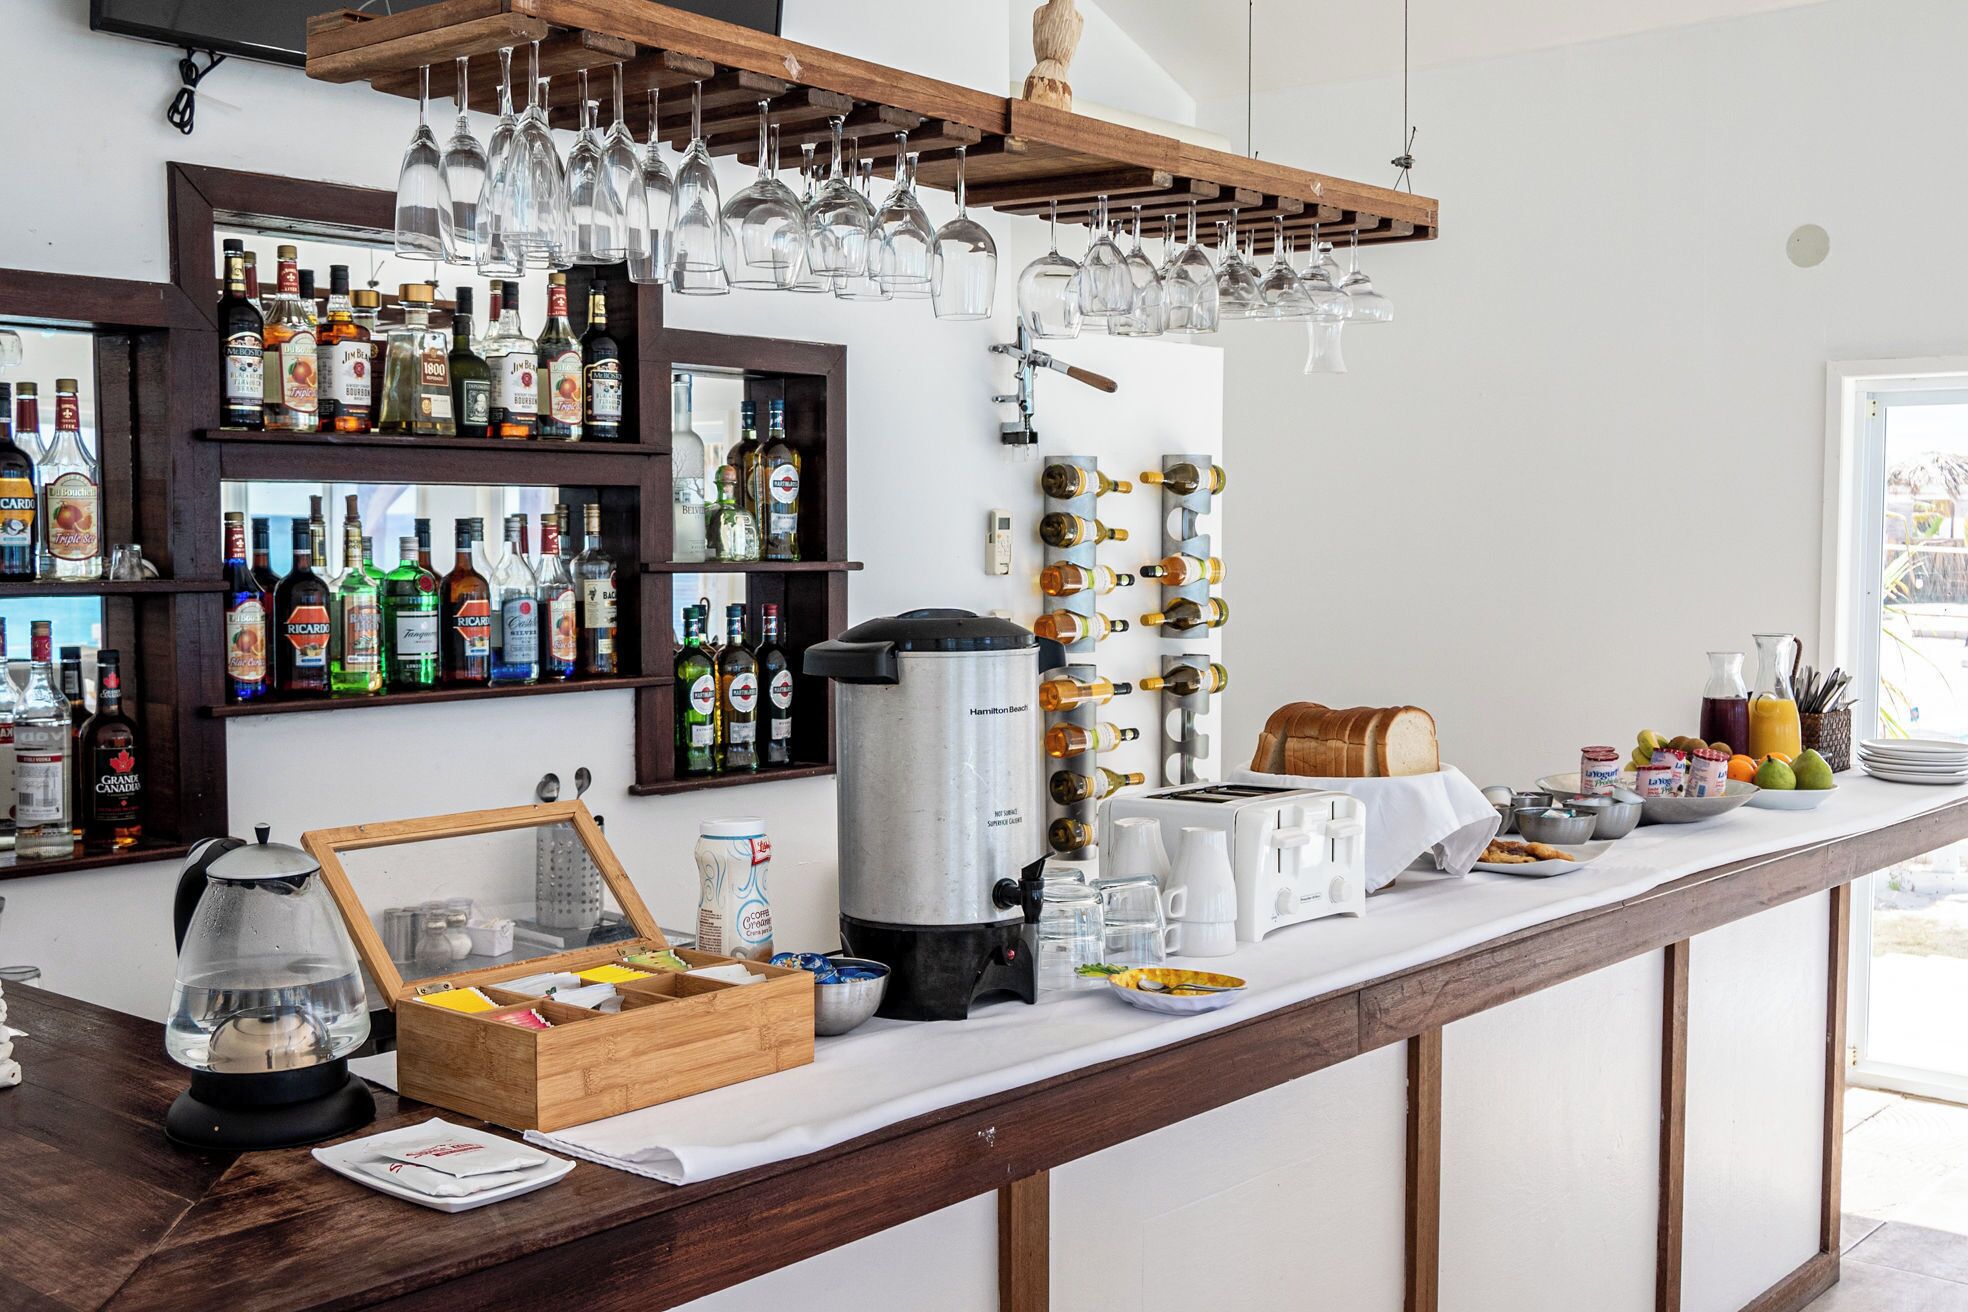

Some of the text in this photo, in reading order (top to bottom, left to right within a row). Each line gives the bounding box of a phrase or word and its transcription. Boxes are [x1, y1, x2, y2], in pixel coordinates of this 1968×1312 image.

[342, 351, 356, 365] JIM
[423, 361, 446, 376] 1800
[511, 362, 524, 375] JIM
[55, 532, 81, 545] Triple
[287, 623, 331, 634] RICARDO
[969, 703, 1029, 717] Hamilton Beach
